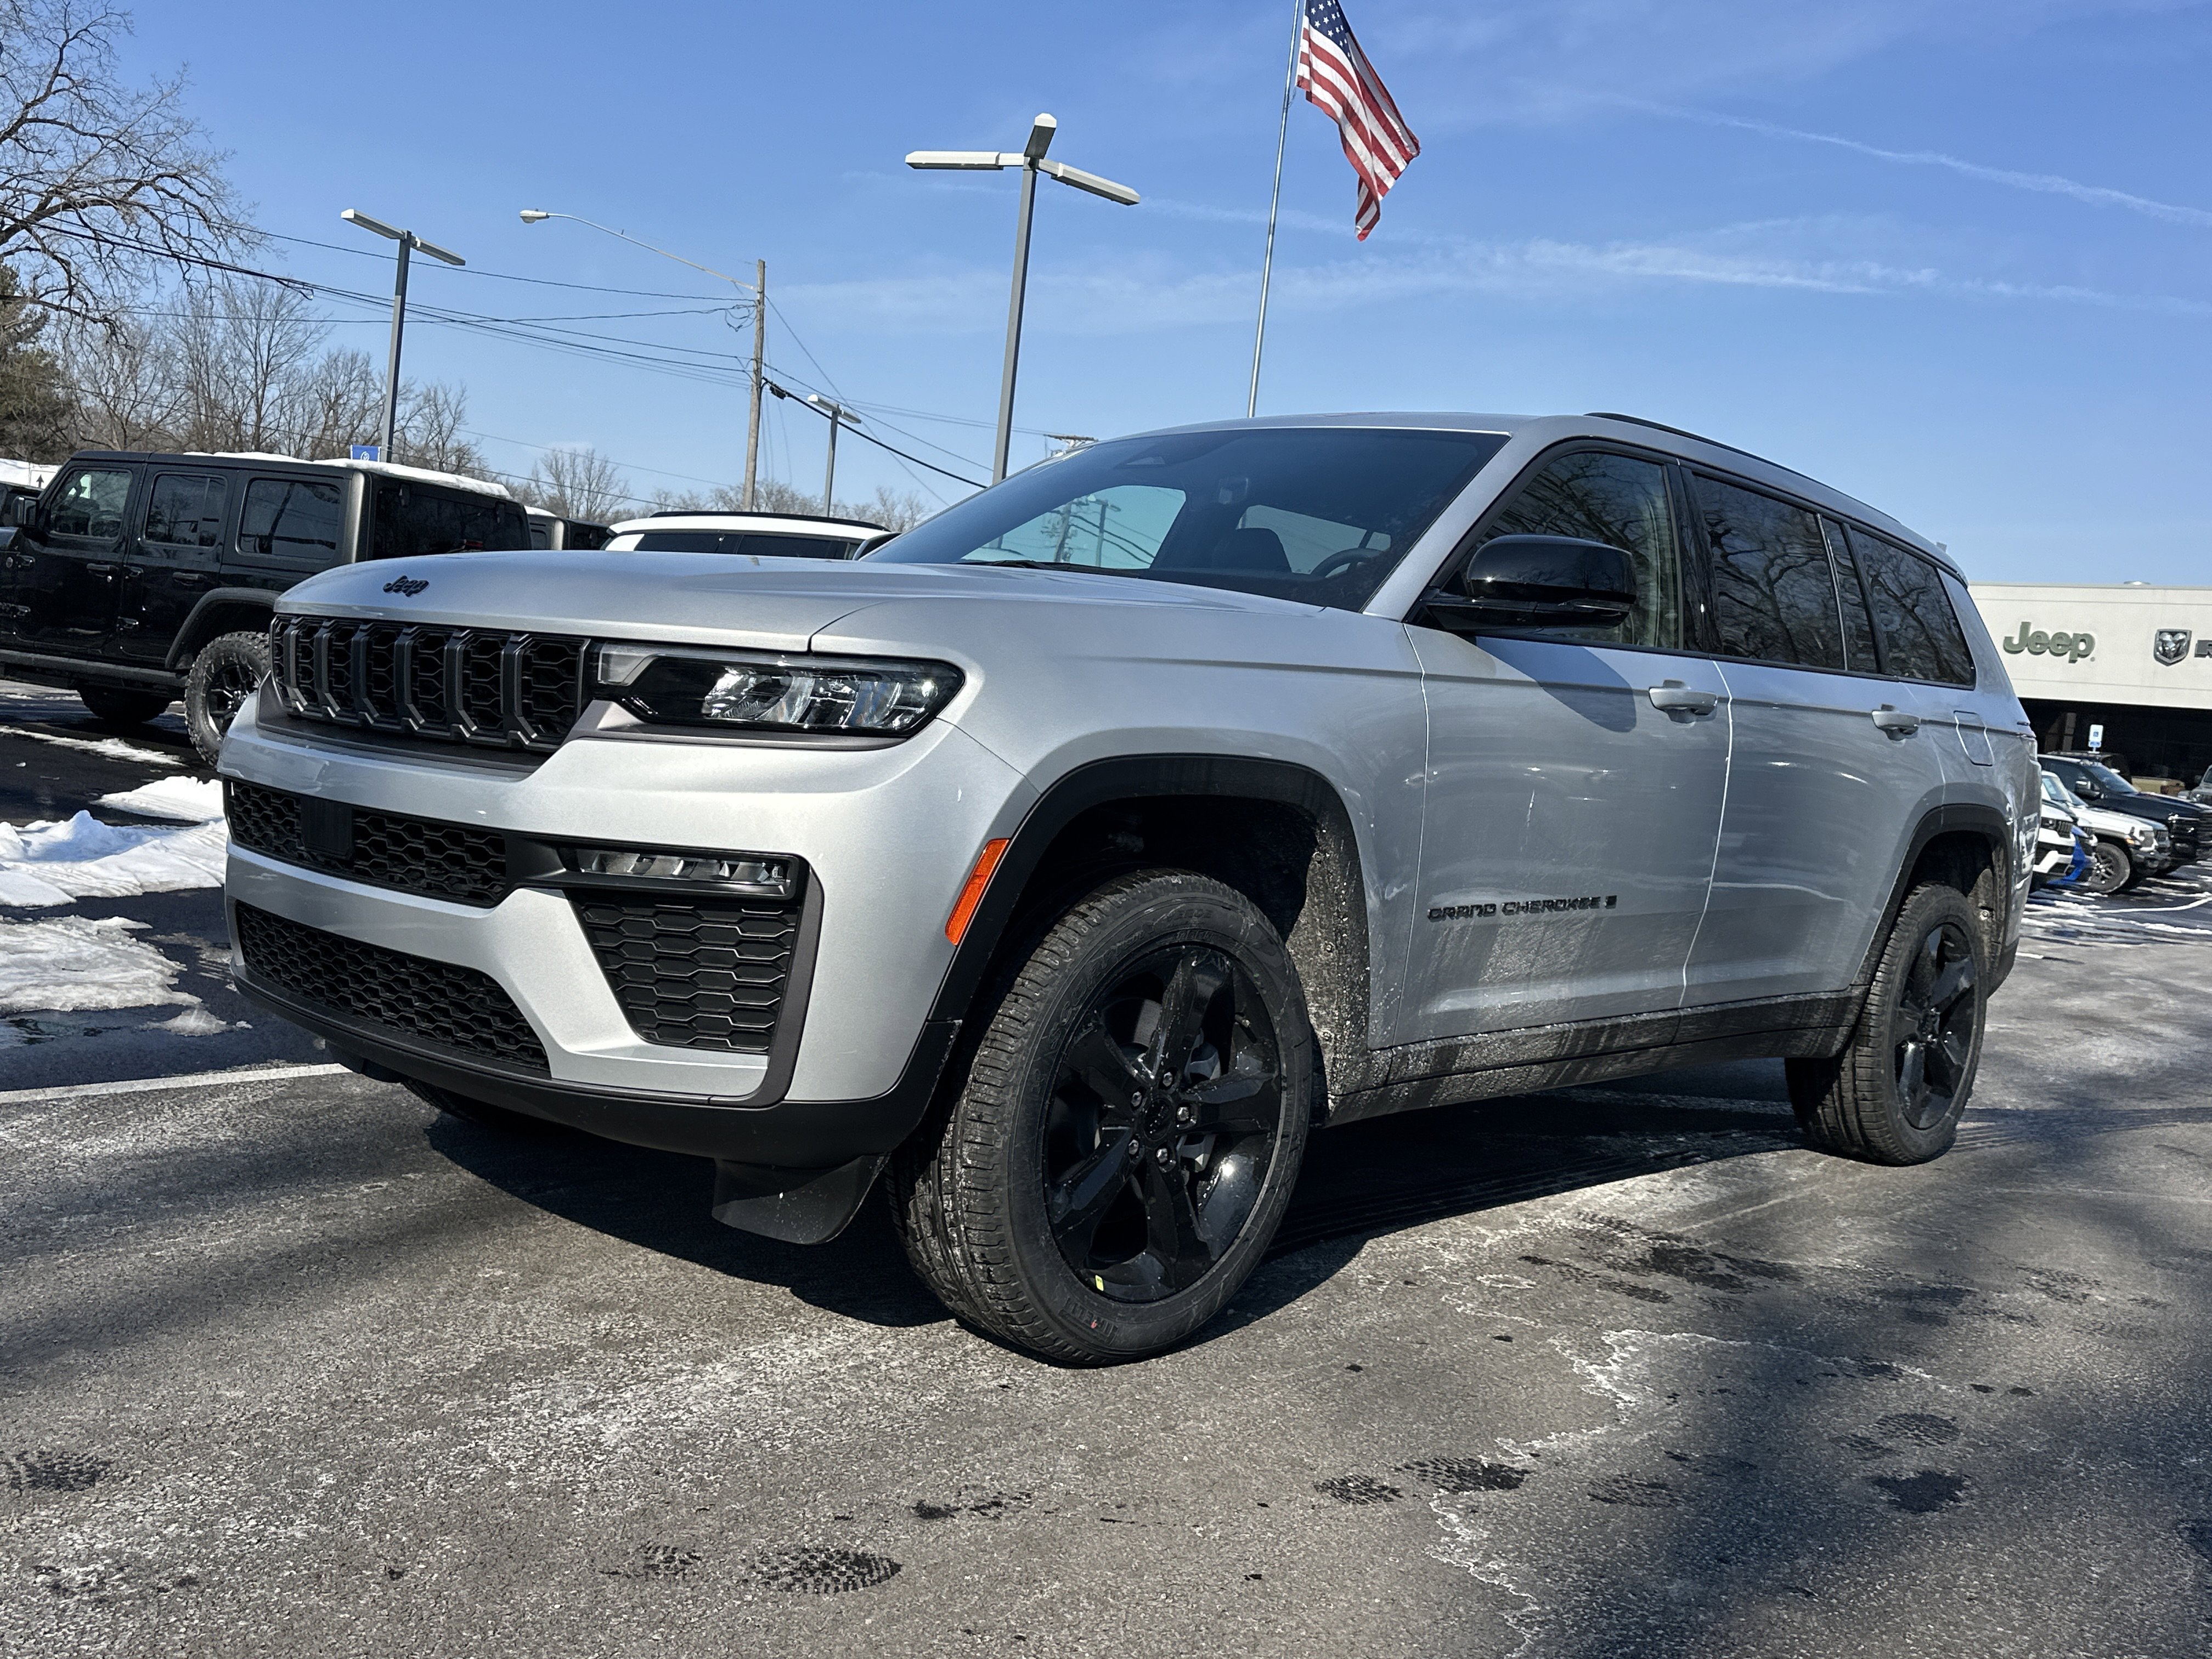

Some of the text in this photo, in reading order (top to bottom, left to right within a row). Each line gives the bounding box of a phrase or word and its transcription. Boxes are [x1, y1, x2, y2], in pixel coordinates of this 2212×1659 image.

[383, 575, 430, 597] Jeep
[2003, 622, 2095, 663] Jeep
[1427, 903, 1497, 922] GRAND
[1502, 896, 1601, 916] CHEROKEE
